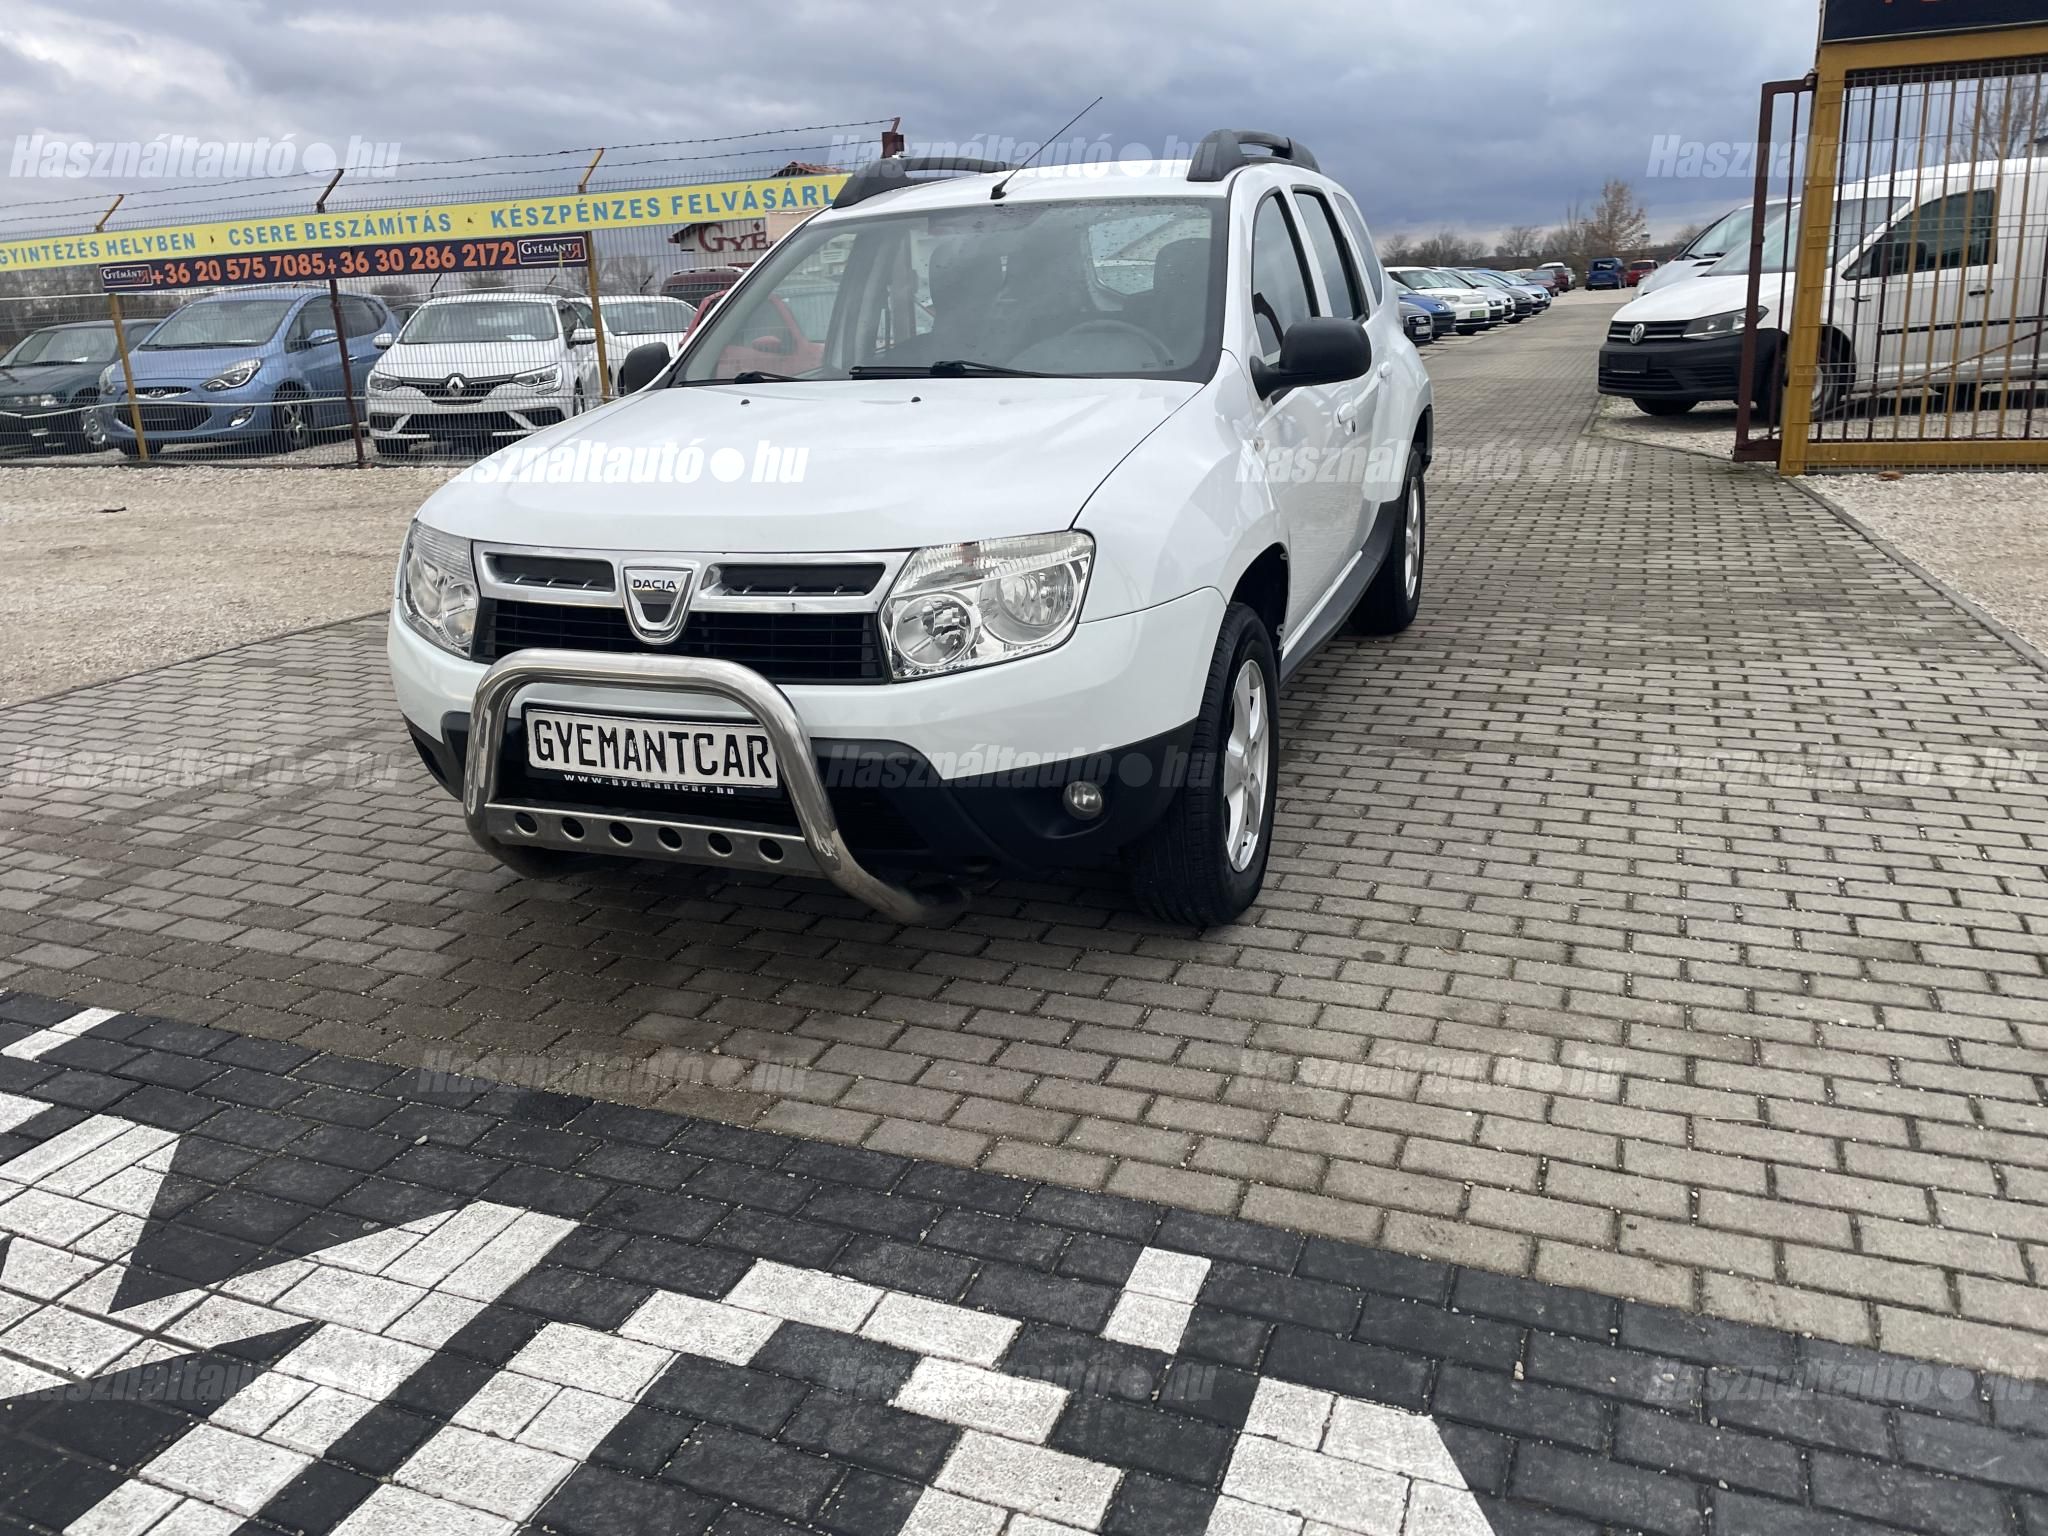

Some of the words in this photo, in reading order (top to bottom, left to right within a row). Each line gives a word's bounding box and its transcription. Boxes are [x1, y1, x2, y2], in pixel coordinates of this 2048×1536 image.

[228, 223, 298, 246] CSERE
[304, 209, 452, 241] BESZÁMÍTÁS
[490, 197, 661, 229] KÉSZPÉNZES
[106, 231, 196, 257] HELYBEN
[195, 259, 221, 281] 20
[225, 256, 266, 281] 575
[375, 248, 404, 272] 30
[409, 245, 456, 270] 286
[460, 241, 517, 268] 2172
[632, 578, 677, 591] DACIA
[533, 719, 773, 780] GYEMANTCAR
